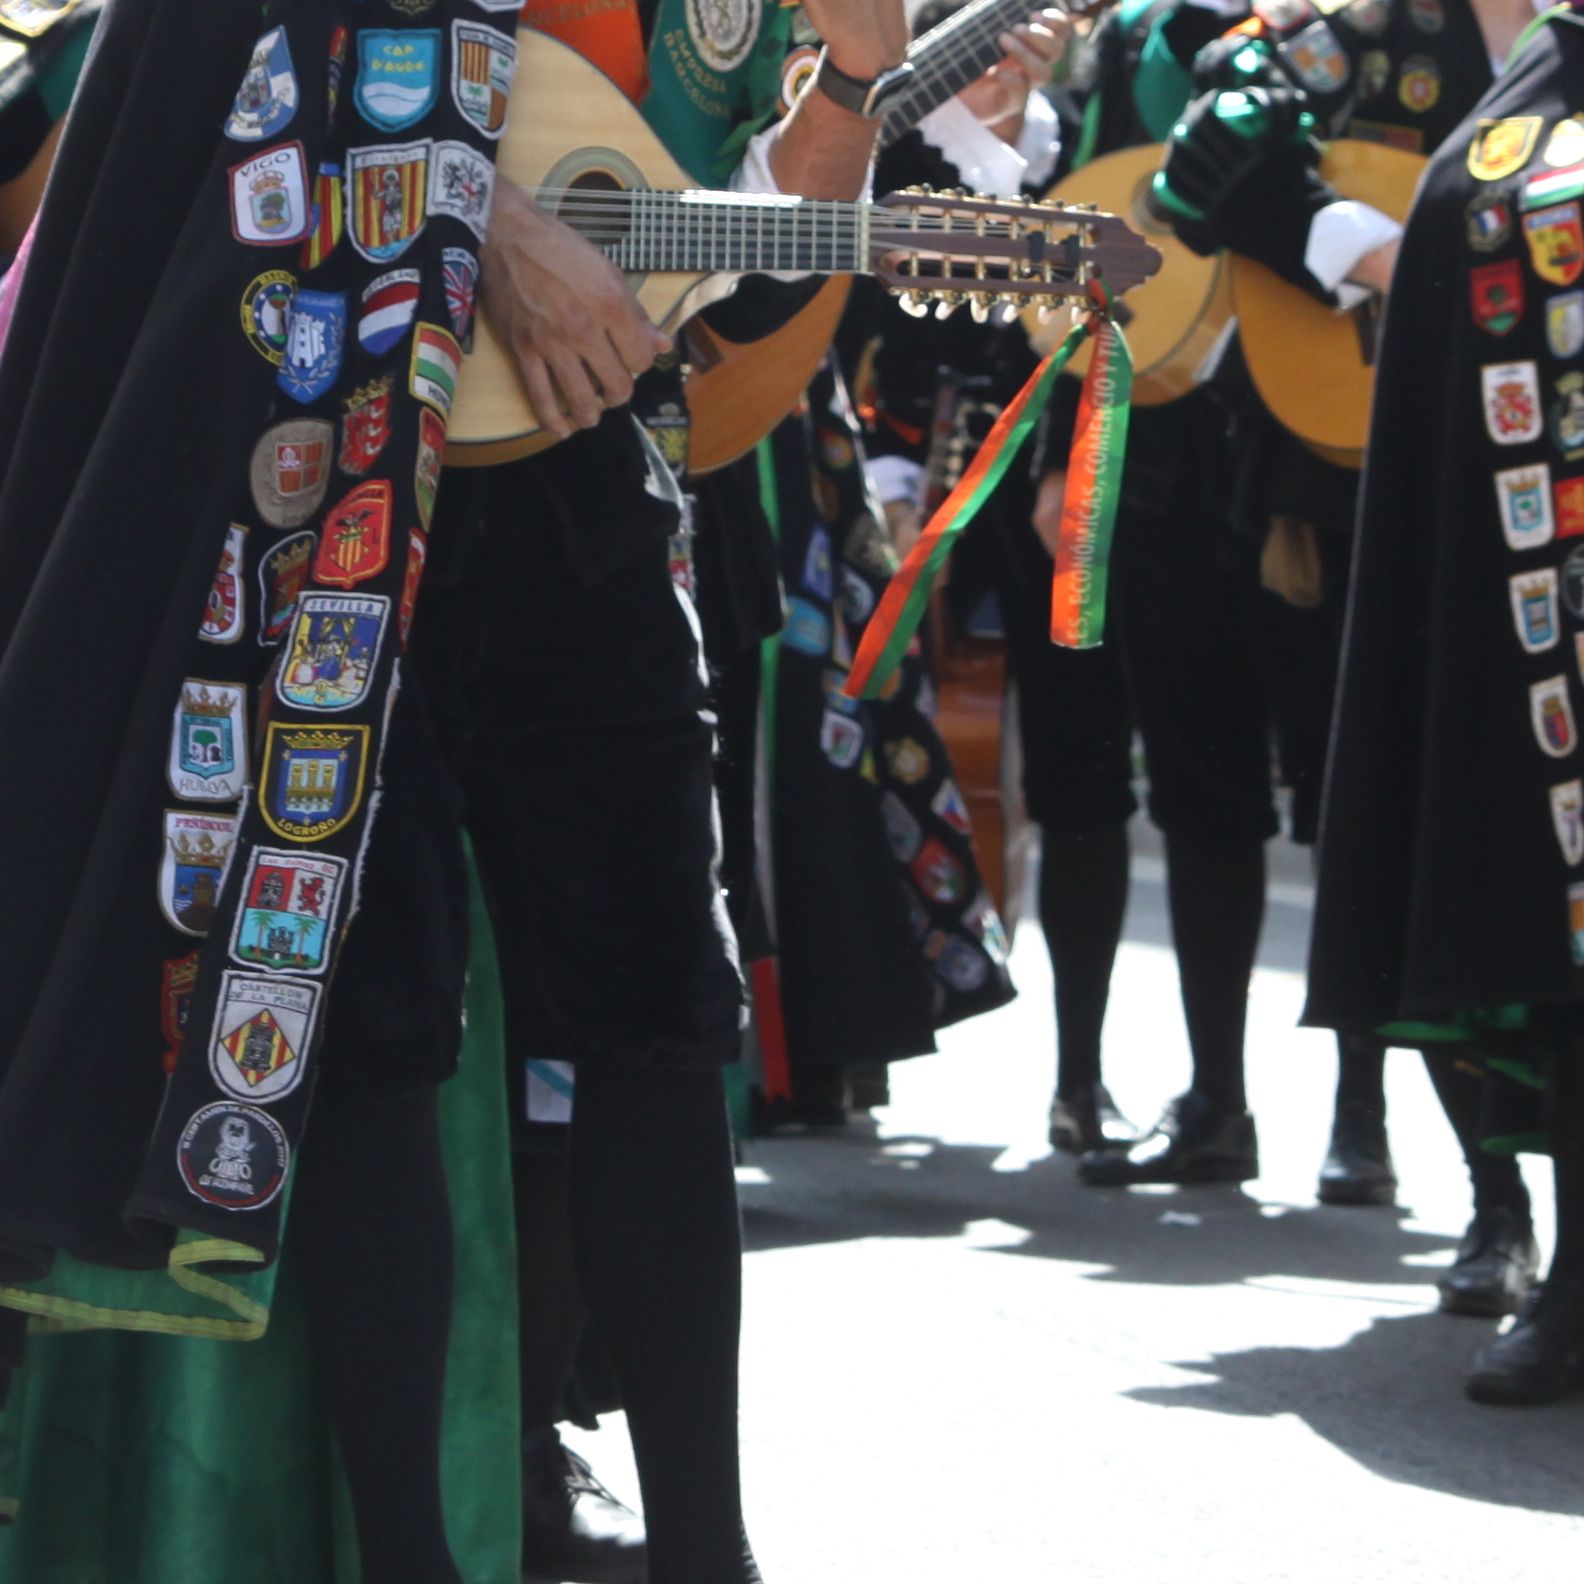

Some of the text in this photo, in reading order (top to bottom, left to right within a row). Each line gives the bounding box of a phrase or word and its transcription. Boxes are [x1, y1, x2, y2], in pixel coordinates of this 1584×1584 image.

[383, 44, 414, 57] CAP
[240, 150, 292, 178] VIGO
[1095, 354, 1118, 368] Y
[1084, 377, 1117, 474] COMERCIO
[1069, 479, 1106, 605] ECONÓMICAS,
[308, 598, 375, 613] SEVILLA
[179, 776, 236, 795] HUELVA
[252, 992, 266, 1002] LA
